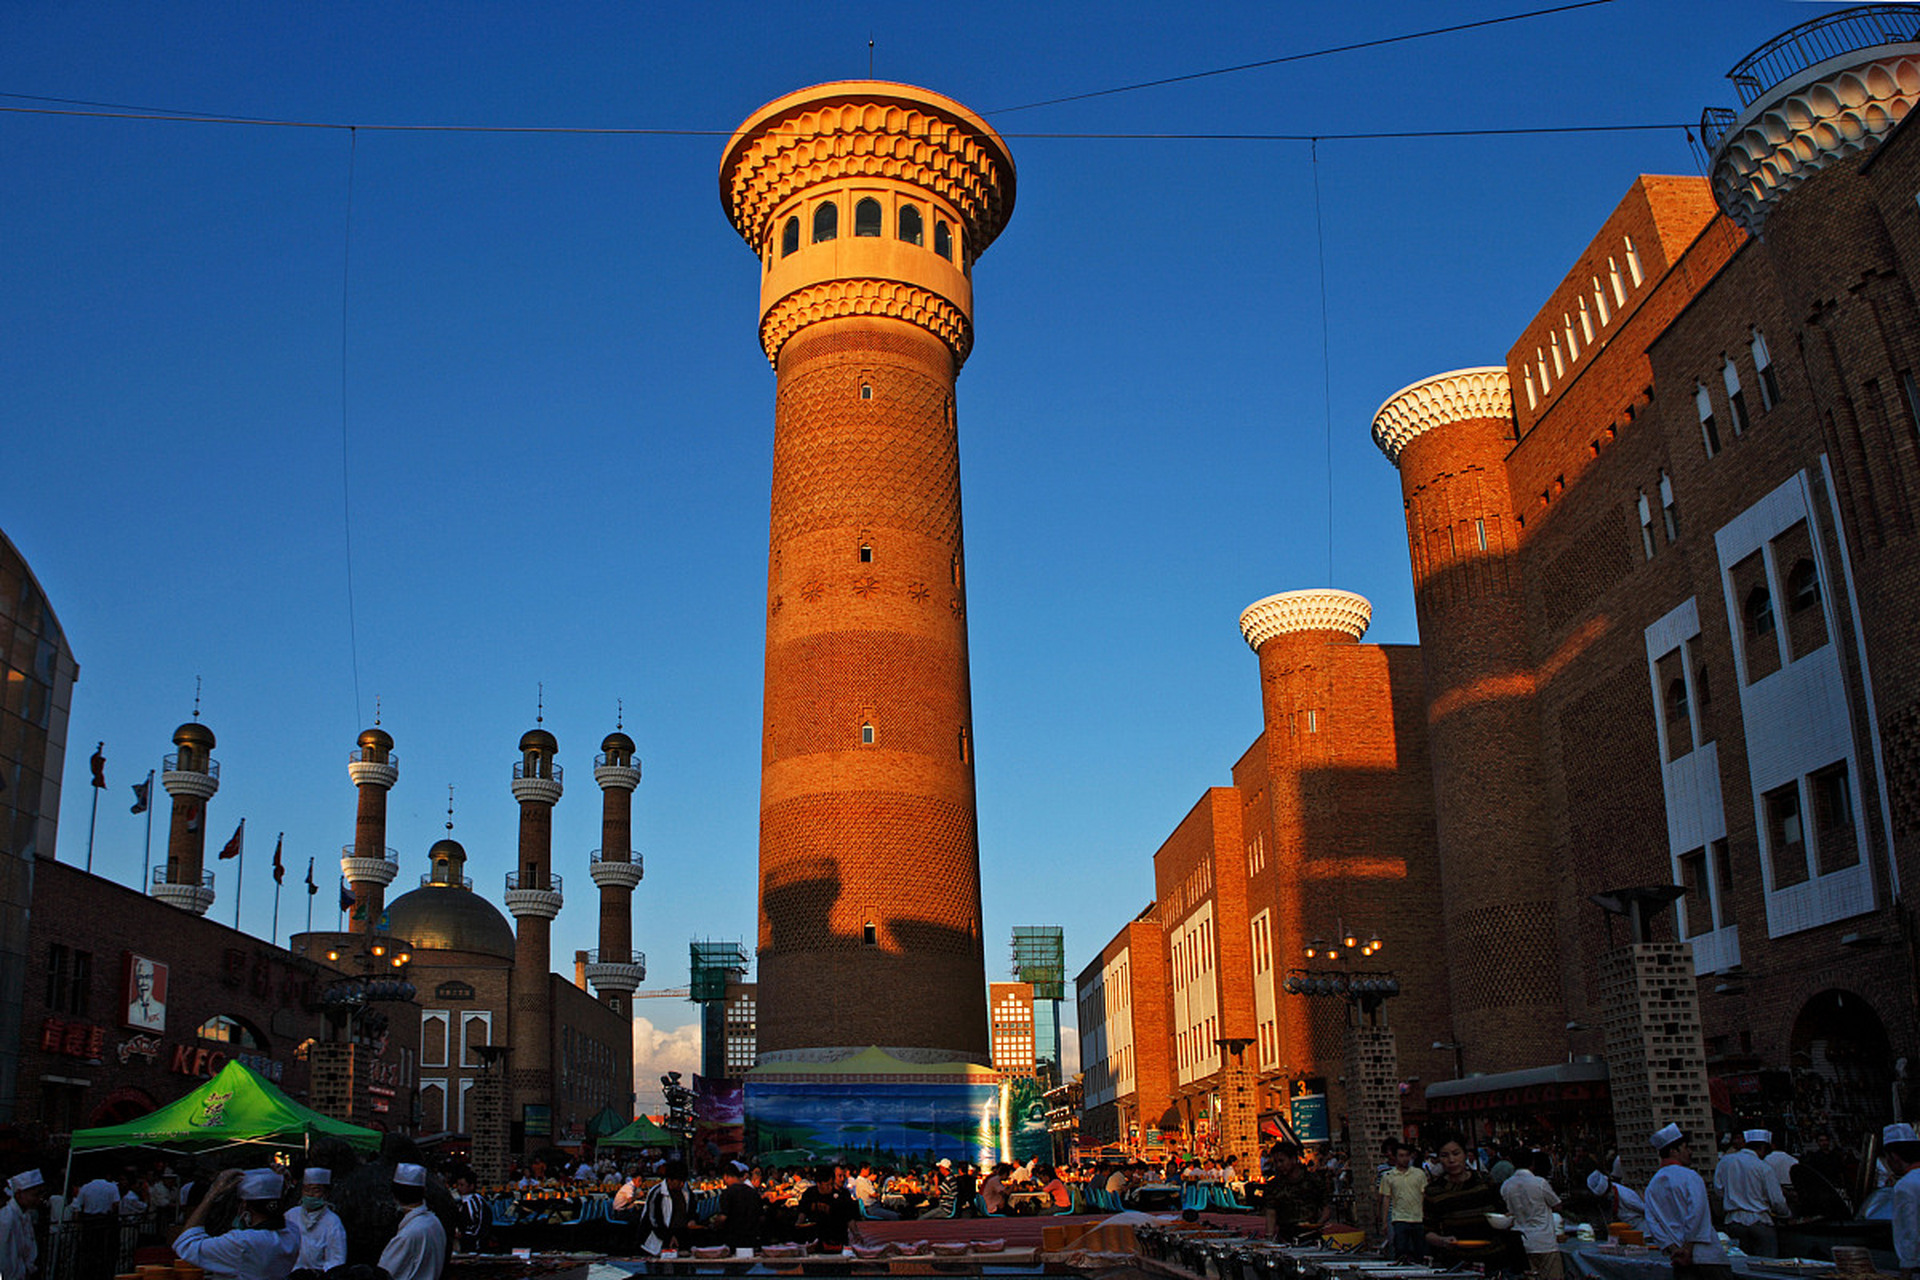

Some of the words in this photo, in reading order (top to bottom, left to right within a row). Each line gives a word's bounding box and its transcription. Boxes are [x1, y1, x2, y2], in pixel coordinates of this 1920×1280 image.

[40, 1017, 104, 1059] 肯德基
[171, 1044, 225, 1077] KFC
